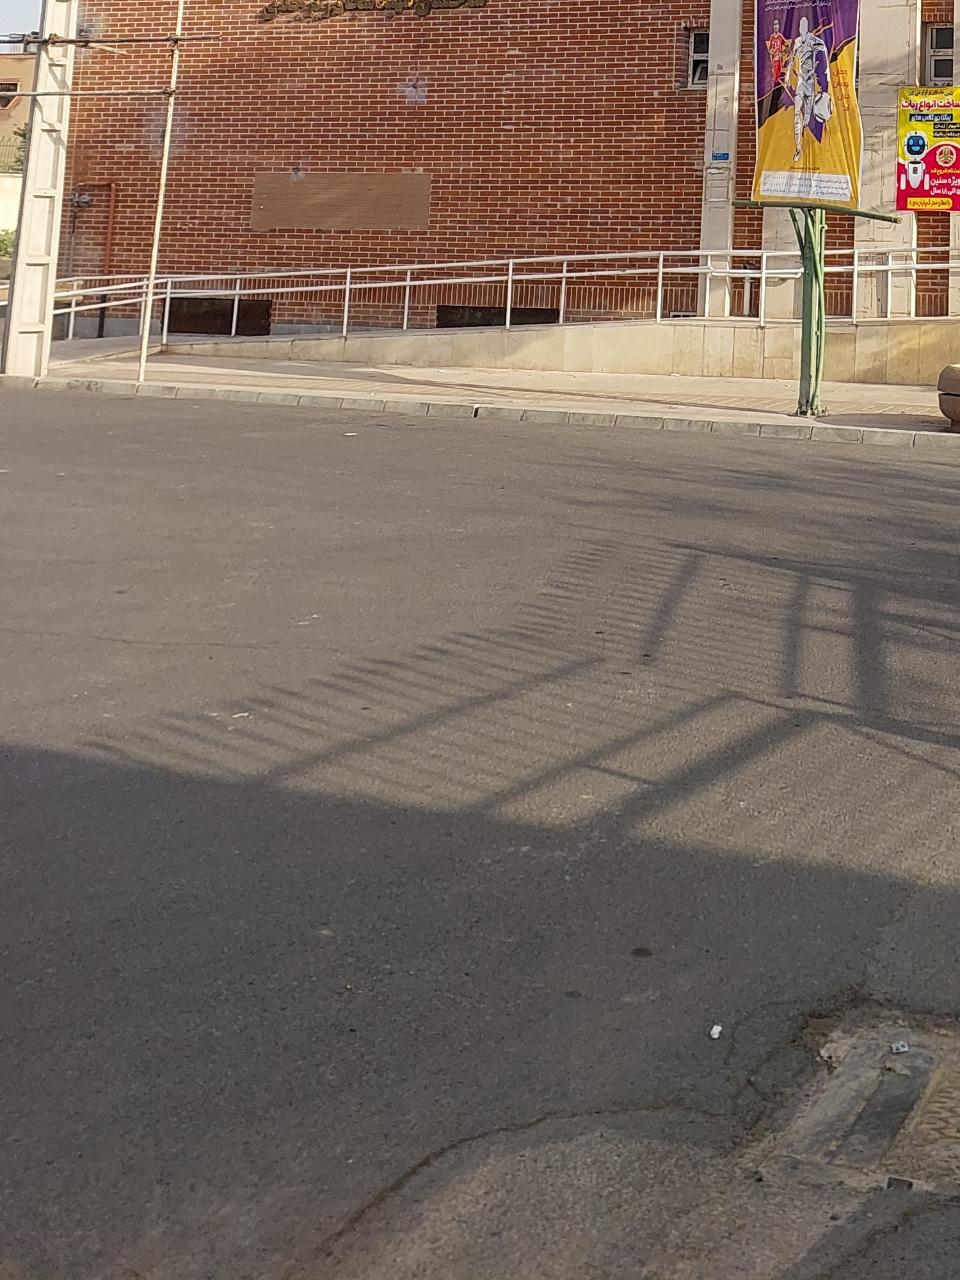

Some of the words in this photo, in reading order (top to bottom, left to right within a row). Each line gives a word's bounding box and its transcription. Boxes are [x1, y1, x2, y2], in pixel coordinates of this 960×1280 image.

[901, 99, 919, 111] ربات
[919, 100, 937, 112] انواع
[937, 98, 960, 109] ساخت
[930, 176, 947, 186] سنین
[948, 175, 960, 186] ویژه
[930, 187, 941, 196] سال
[941, 187, 947, 195] ۱۸
[948, 187, 957, 195] الی
